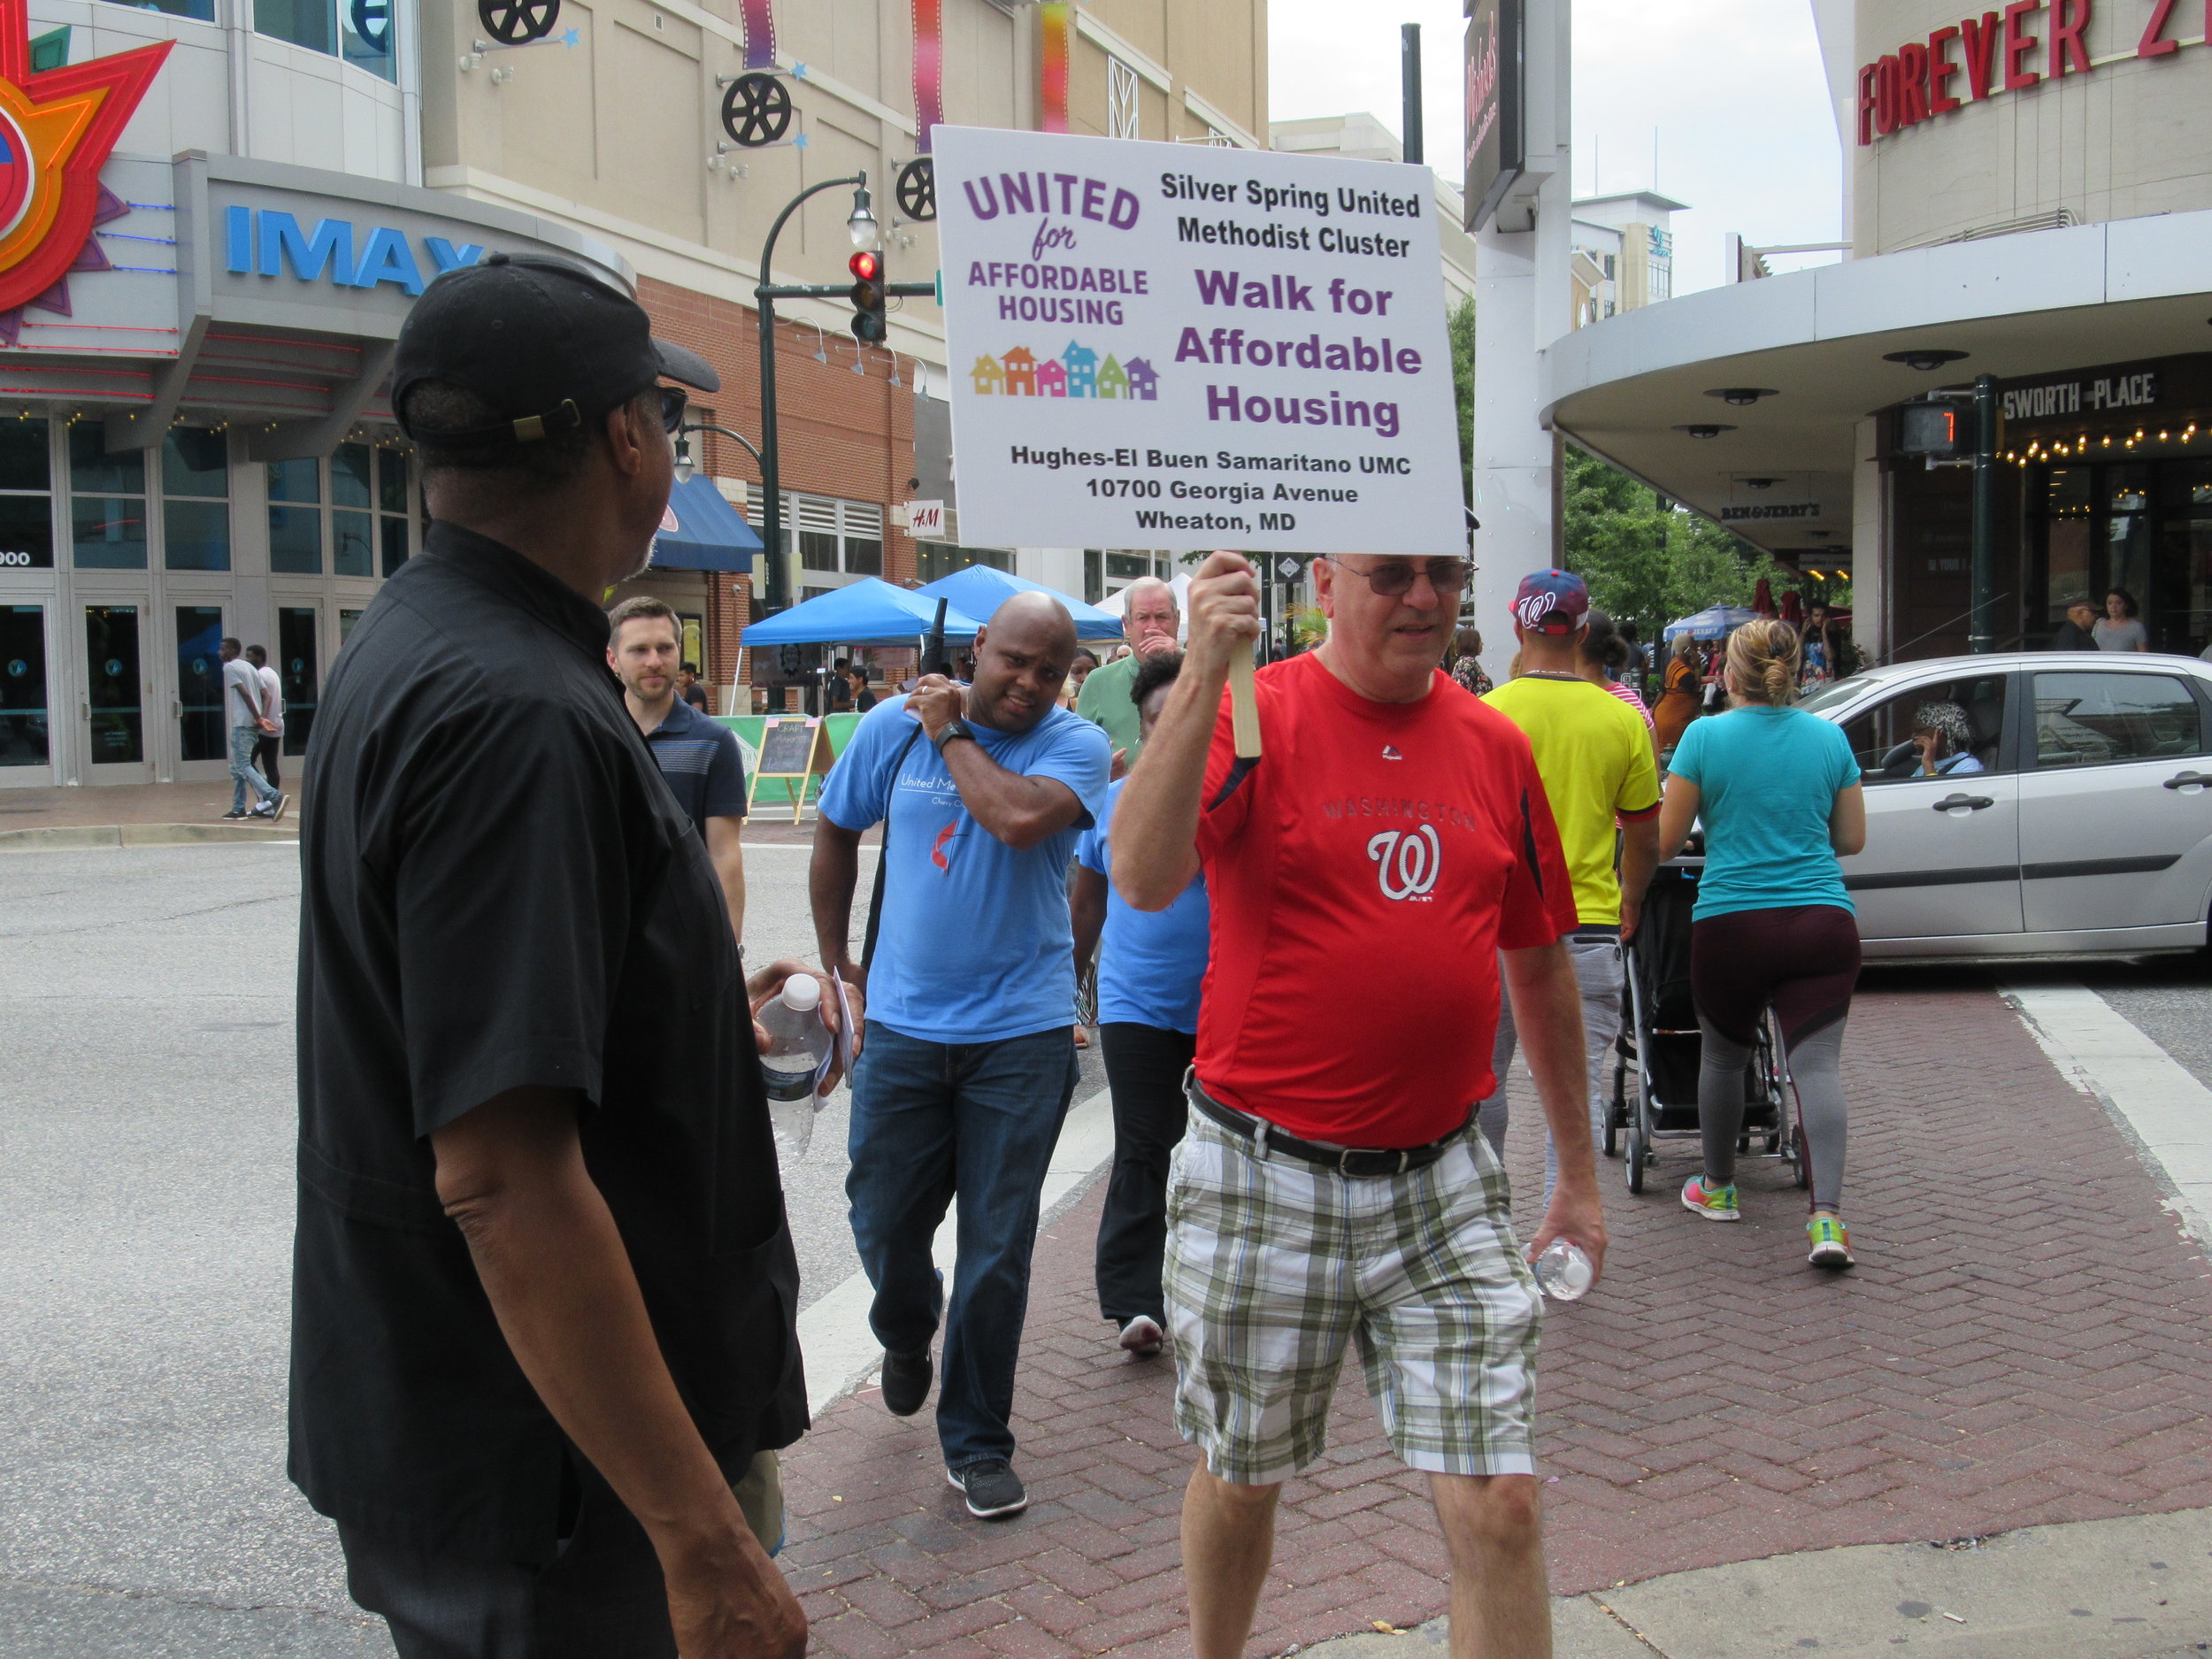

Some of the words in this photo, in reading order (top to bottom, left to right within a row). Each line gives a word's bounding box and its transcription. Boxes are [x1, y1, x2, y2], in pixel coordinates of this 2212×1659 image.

[1858, 0, 2092, 146] FOREVER
[964, 173, 1140, 230] UNITED
[1161, 173, 1237, 203] Silver
[1246, 180, 1329, 217] Spring
[1338, 188, 1420, 218] United
[1033, 218, 1076, 261] for
[1178, 217, 1310, 250] Methodist
[1318, 227, 1409, 257] Cluster
[969, 262, 1148, 295] AFFORDABLE
[1194, 270, 1314, 311] Walk
[1329, 279, 1393, 316] for
[999, 296, 1123, 325] HOUSING
[1175, 327, 1421, 374] Affordable
[2093, 373, 2154, 410] PLACE
[1207, 385, 1399, 437] Housing
[1011, 446, 1137, 469] Hughes-El
[1147, 449, 1208, 468] Buen
[1217, 451, 1351, 472] Samaritano
[1359, 457, 1410, 474] UMC
[1087, 479, 1161, 498] 10700
[1170, 480, 1263, 504] Georgia
[1273, 483, 1358, 503] Avenue
[912, 508, 939, 527] H&M
[1135, 511, 1250, 534] Wheaton,
[1259, 513, 1295, 530] MD
[901, 773, 935, 788] United
[932, 797, 953, 806] Chevy
[1323, 798, 1476, 832] WASHINGTON
[1367, 824, 1441, 902] W
